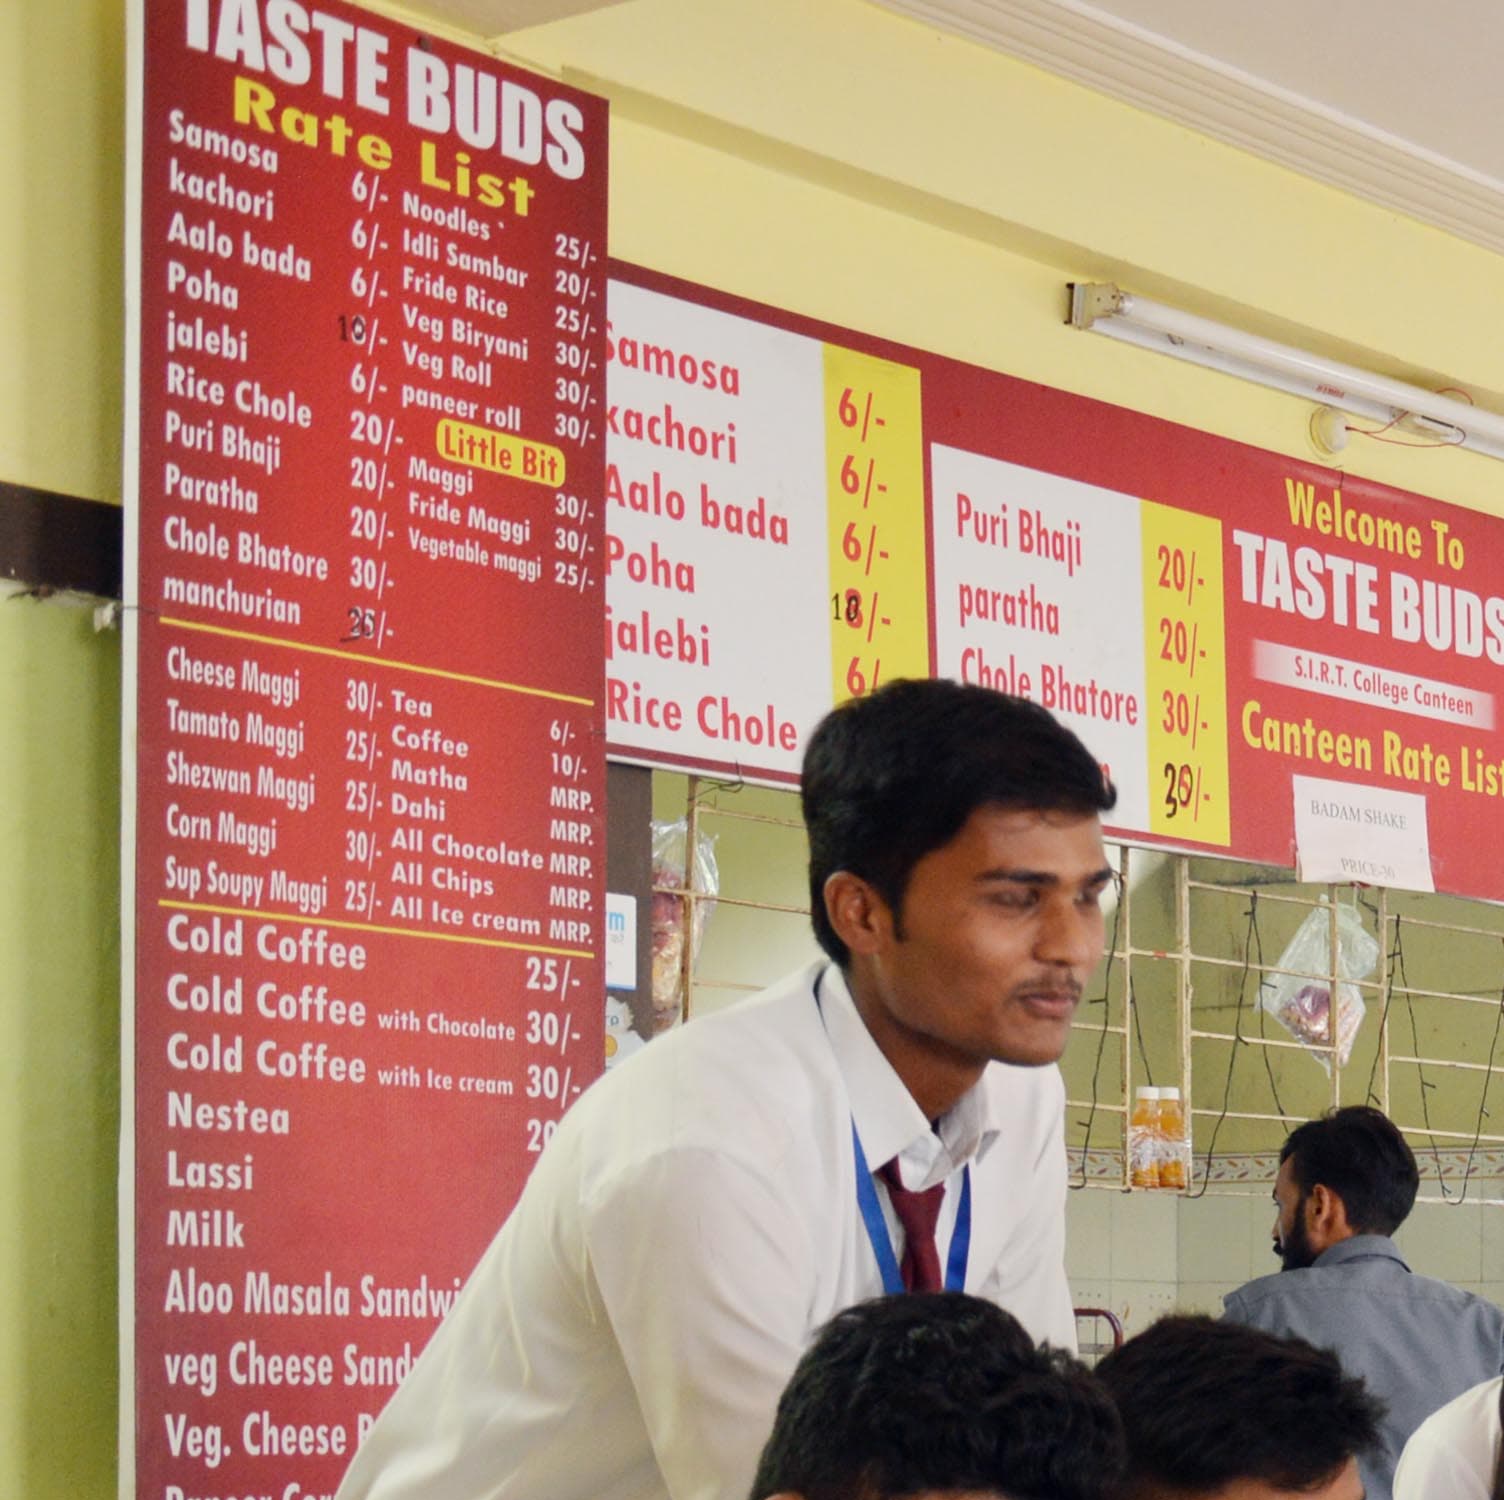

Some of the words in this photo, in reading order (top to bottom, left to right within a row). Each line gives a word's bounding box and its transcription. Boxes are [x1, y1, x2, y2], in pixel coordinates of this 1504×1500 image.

[408, 47, 584, 179] BUDS
[170, 110, 277, 173] Samosa
[231, 77, 392, 173] Rate
[421, 141, 534, 216] List
[170, 158, 273, 221] kachori
[403, 191, 490, 240] Noodles
[168, 212, 232, 258] Aalo
[243, 237, 311, 281] bada
[404, 229, 438, 260] Idli
[447, 243, 528, 287] Sambar
[168, 261, 238, 309] Poha
[403, 266, 457, 303] Fride
[466, 285, 507, 318] Rice
[168, 311, 247, 362] jalebi
[403, 304, 443, 342] Veg
[452, 318, 527, 361] Biryani
[168, 362, 224, 405] Rice
[235, 381, 311, 428] Chole
[402, 385, 478, 419] paneer
[486, 406, 520, 431] roll
[166, 410, 213, 452] Puri
[222, 425, 280, 475] Bhaji
[445, 426, 511, 469] Little
[523, 442, 557, 482] Bit
[166, 463, 258, 514] Paratha
[409, 456, 472, 496] Maggi
[605, 463, 685, 522] Aalo
[701, 483, 788, 544] bada
[409, 492, 460, 524] Fride
[468, 506, 530, 545] Maggi
[957, 493, 1007, 547] Puri
[1019, 509, 1081, 576] Bhaji
[1286, 479, 1421, 558] Welcome
[1431, 520, 1464, 570] To
[164, 516, 229, 560] Chole
[238, 532, 328, 580] Bhatore
[409, 527, 488, 566] Vegetable
[494, 553, 541, 582] maggi
[605, 534, 696, 594] Poha
[164, 577, 300, 624] manchurian
[959, 584, 1059, 635] paratha
[1233, 530, 1379, 634] TASTE
[167, 646, 235, 689] Cheese
[242, 660, 299, 707] Maggi
[392, 690, 432, 717] Tea
[1041, 664, 1139, 726] Bhatore
[1294, 656, 1348, 690] S.I.R.T.
[1354, 670, 1407, 704] College
[1414, 684, 1473, 715] Canteen
[167, 699, 239, 741] Tamato
[246, 712, 303, 759] Maggi
[392, 725, 468, 757] Coffee
[607, 679, 683, 732] Rice
[697, 696, 796, 751] Chole
[1242, 701, 1371, 770] Canteen
[1383, 731, 1452, 787] Rate
[167, 751, 251, 794] Shezwan
[257, 766, 314, 812] Maggi
[392, 759, 467, 791] Matha
[550, 786, 593, 812] MRP.
[392, 793, 445, 821] Dahi
[167, 804, 211, 840] Corn
[218, 811, 276, 857] Maggi
[1310, 800, 1360, 823] BADAM
[1364, 808, 1407, 830] SHAKE
[391, 828, 422, 852] All
[432, 833, 543, 869] Chocolate
[166, 856, 201, 899] Sup
[207, 861, 263, 907] Soupy
[270, 870, 327, 914] Maggi
[168, 914, 242, 956] Cold
[257, 925, 366, 970] Coffee
[391, 896, 422, 920] All
[432, 901, 463, 925] Ice
[472, 912, 540, 935] cream
[168, 974, 242, 1014] Cold
[257, 983, 365, 1026] Coffee
[378, 1009, 420, 1031] with
[427, 1013, 515, 1041] Chocolate
[168, 1091, 289, 1134] Nestea
[168, 1151, 252, 1190] Lassi
[167, 1210, 244, 1247] Milk
[165, 1267, 232, 1313] Aloo
[245, 1272, 349, 1316] Masala
[165, 1354, 216, 1396] veg
[229, 1340, 333, 1385] Cheese
